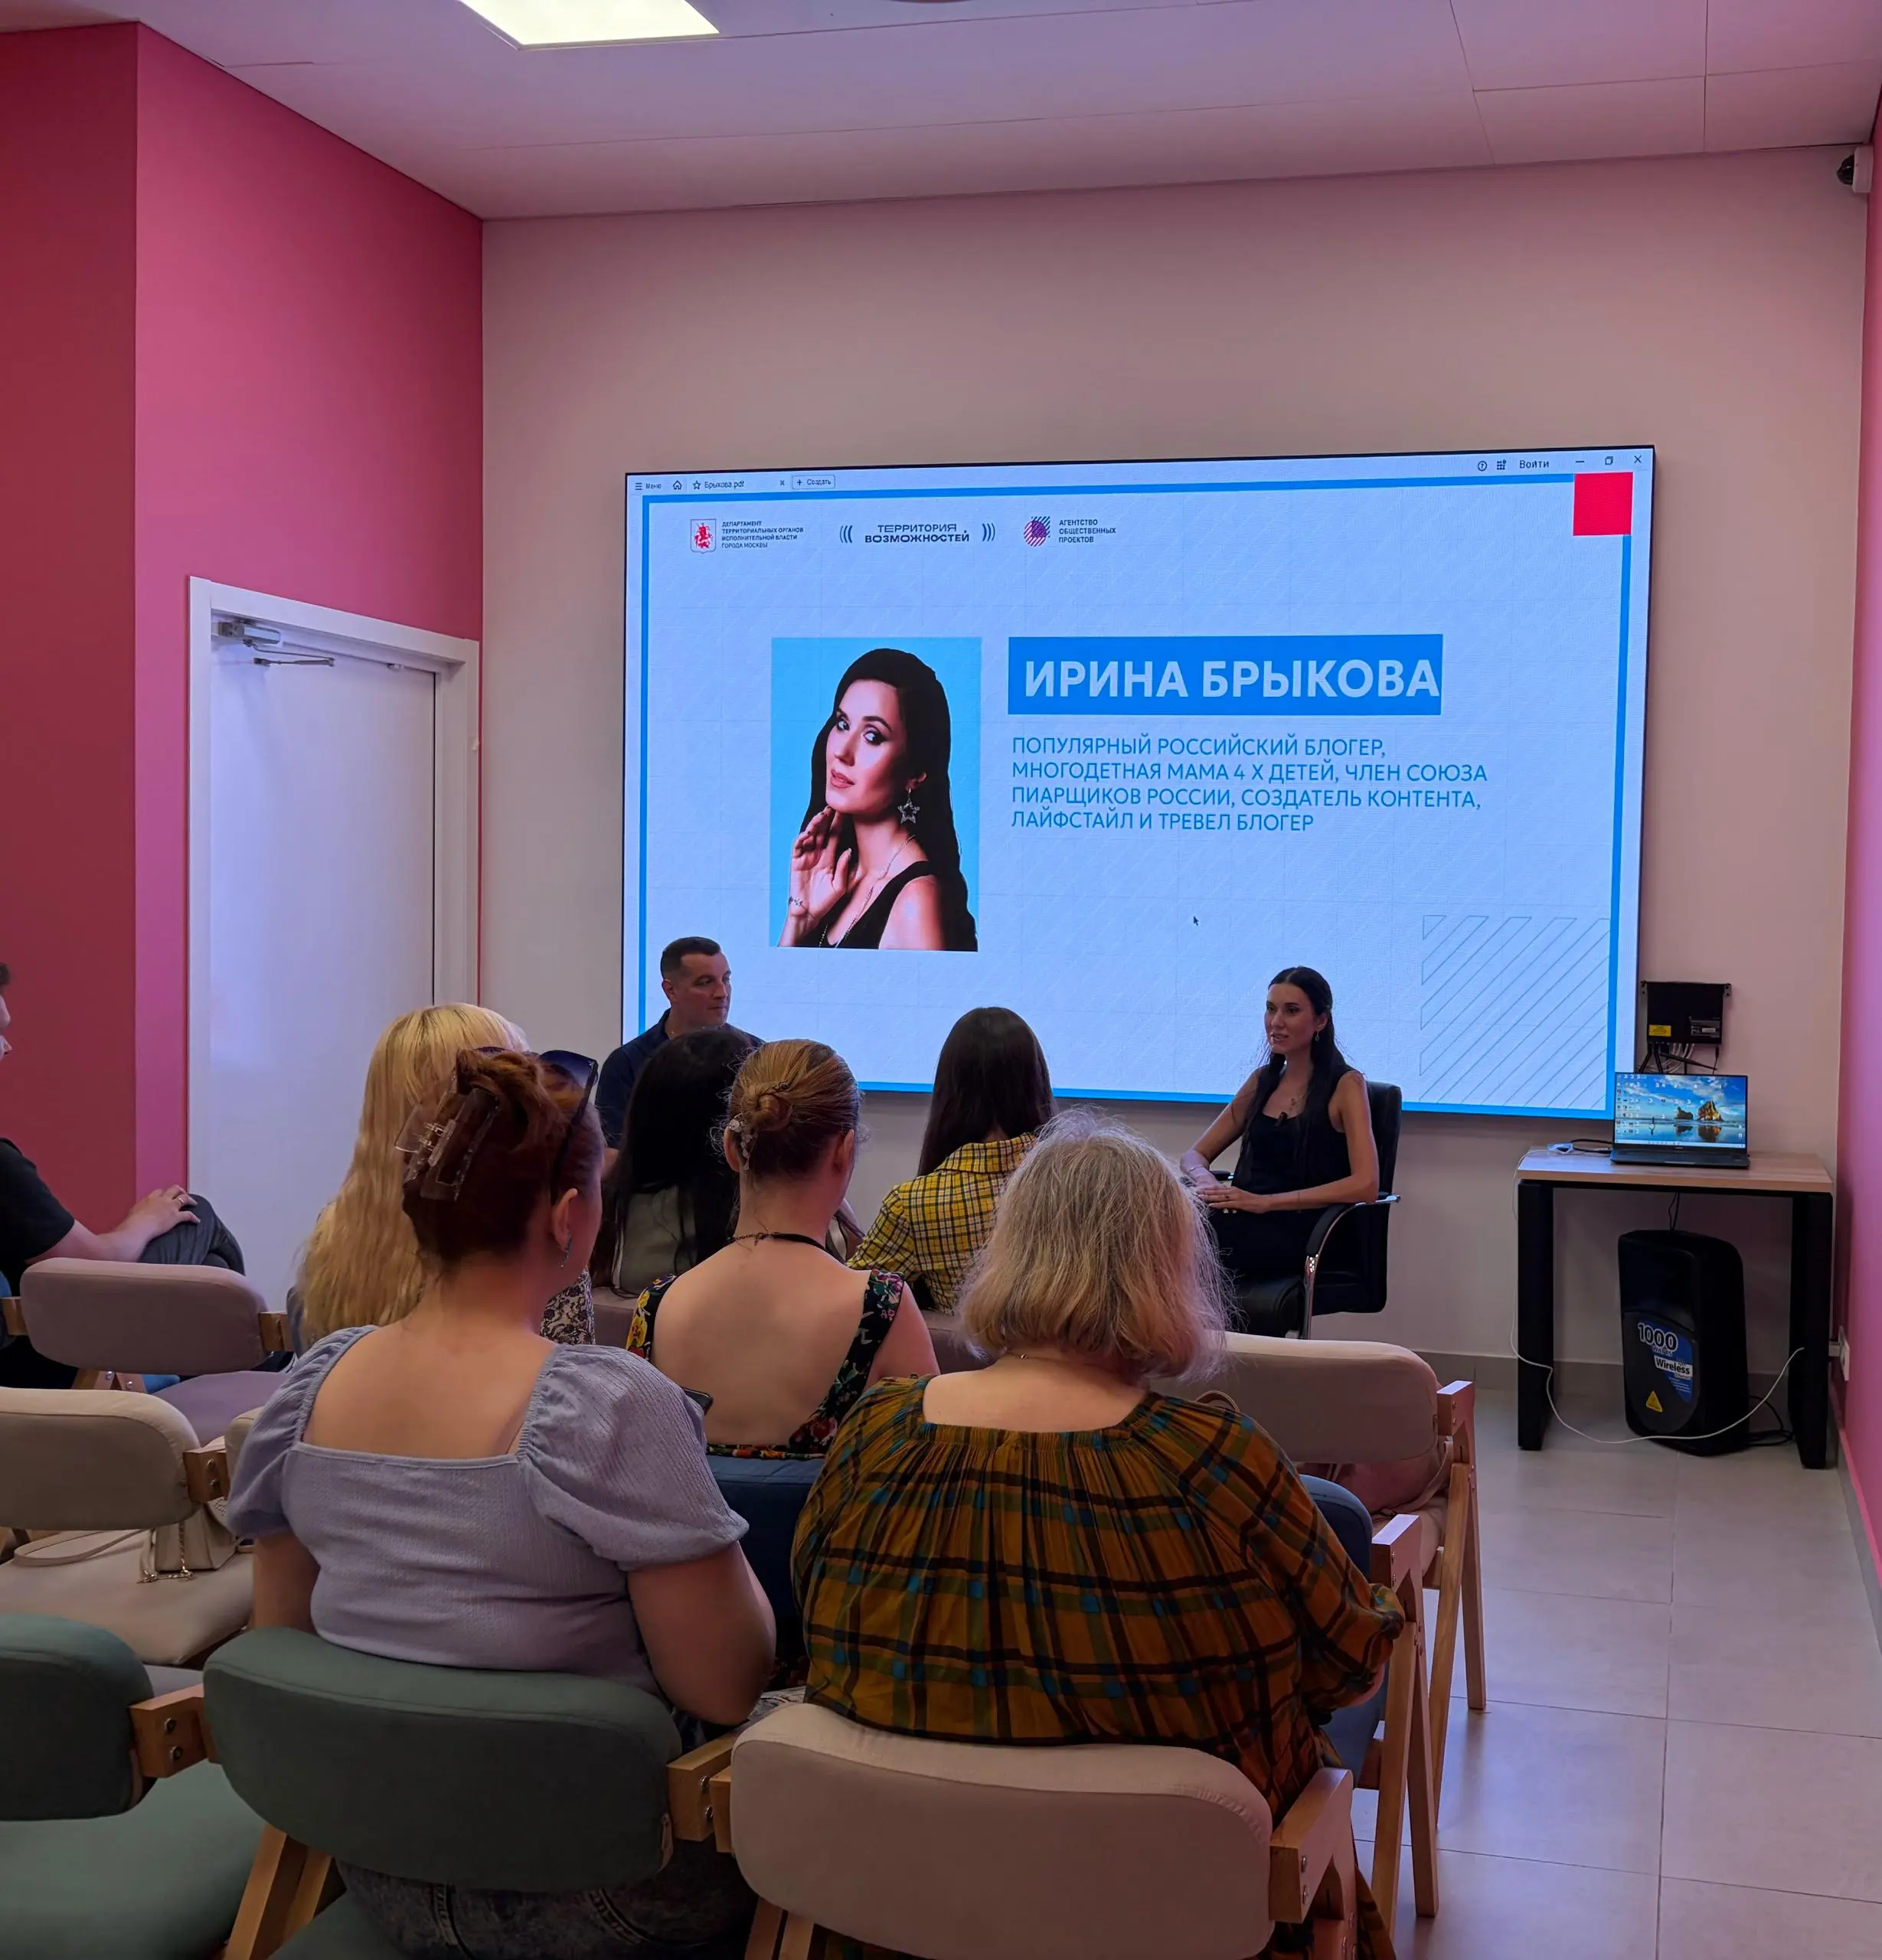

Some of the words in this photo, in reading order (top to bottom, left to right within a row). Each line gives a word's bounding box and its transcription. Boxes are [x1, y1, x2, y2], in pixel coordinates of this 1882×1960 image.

[1519, 459, 1550, 469] Войти
[704, 480, 745, 489] Брыкова.pdf
[806, 478, 832, 486] Создать
[864, 530, 969, 543] ВОЗМОЖНОСТЕЙ
[877, 524, 957, 533] ТЕРРИТОРИЯ
[1058, 527, 1116, 535] ОБЩЕСТВЕННЫХ
[1024, 660, 1189, 698] ИРИНА
[1203, 658, 1440, 698] БРЫКОВА
[1012, 733, 1152, 754] ПОПУЛЯРНЫЙ
[1158, 733, 1299, 756] РОССИЙСКИЙ
[1305, 738, 1386, 758] БЛОГЕР,
[1012, 762, 1162, 783] МНОГОДЕТНАЯ
[1168, 763, 1230, 780] МАМА
[1233, 763, 1246, 780] 4
[1251, 763, 1264, 781] Х
[1268, 759, 1339, 785] ДЕТЕЙ,
[1345, 764, 1400, 781] ЧЛЕН
[1407, 764, 1488, 782] СОЮЗА
[1012, 786, 1142, 807] ПИАРЩИКОВ
[1148, 788, 1235, 808] РОССИИ,
[1241, 789, 1362, 810] СОЗДАТЕЛЬ
[1367, 790, 1482, 810] КОНТЕНТА,
[1011, 805, 1133, 829] ЛАЙФСТАЙЛ
[1139, 812, 1152, 829] И
[1158, 813, 1230, 830] ТРЕВЕЛ
[1237, 814, 1314, 831] БЛОГЕР
[1637, 1322, 1678, 1353] 1000
[1655, 1357, 1691, 1375] Wireless
